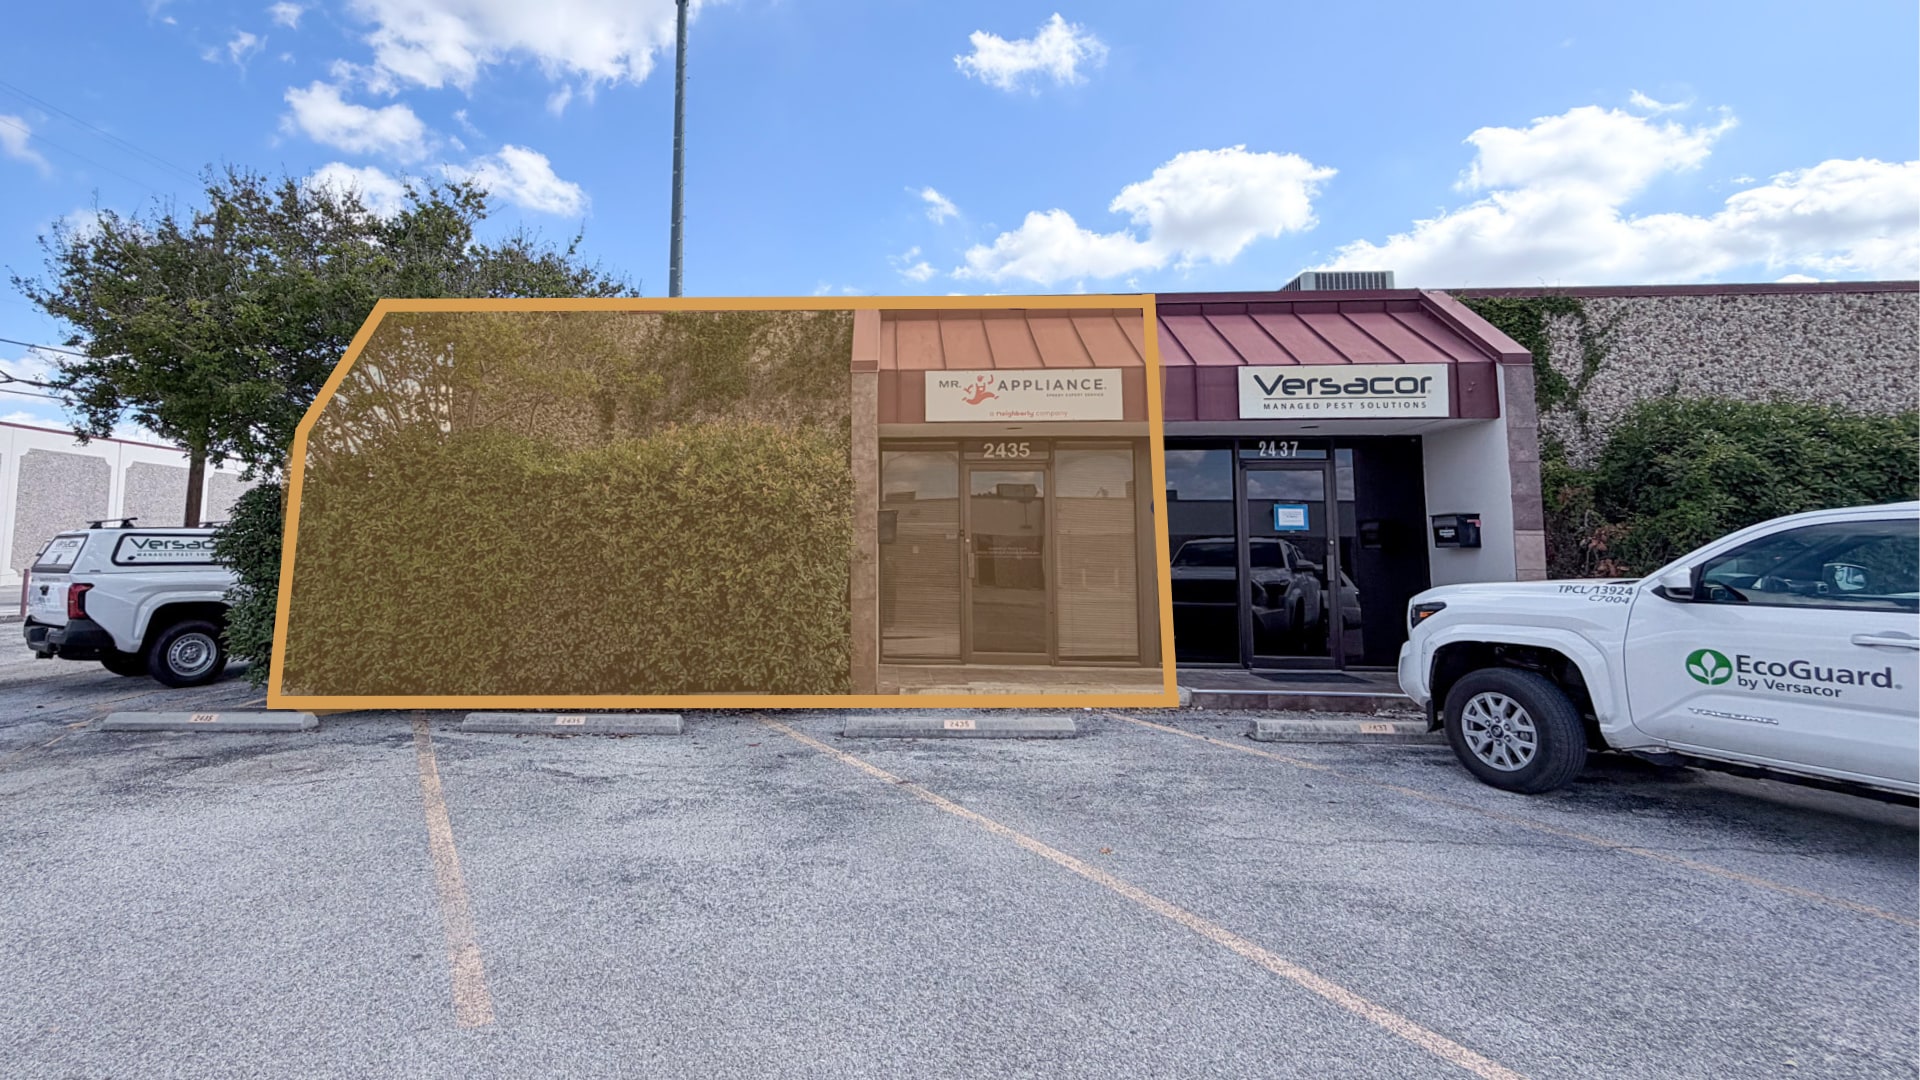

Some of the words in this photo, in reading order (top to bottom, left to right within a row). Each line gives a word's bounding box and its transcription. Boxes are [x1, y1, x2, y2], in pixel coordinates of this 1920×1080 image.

[939, 380, 962, 389] MR.
[1253, 374, 1432, 396] Versacor
[1263, 402, 1320, 410] MANAGED
[1360, 401, 1427, 409] SOLUTIONS
[983, 442, 1031, 458] 2435
[1259, 441, 1299, 457] 2437
[1588, 594, 1631, 604] C7004
[1736, 654, 1893, 689] EcoGuard
[1738, 675, 1758, 690] by
[1763, 678, 1842, 698] Versacor
[1688, 707, 1779, 725] TACOMA
